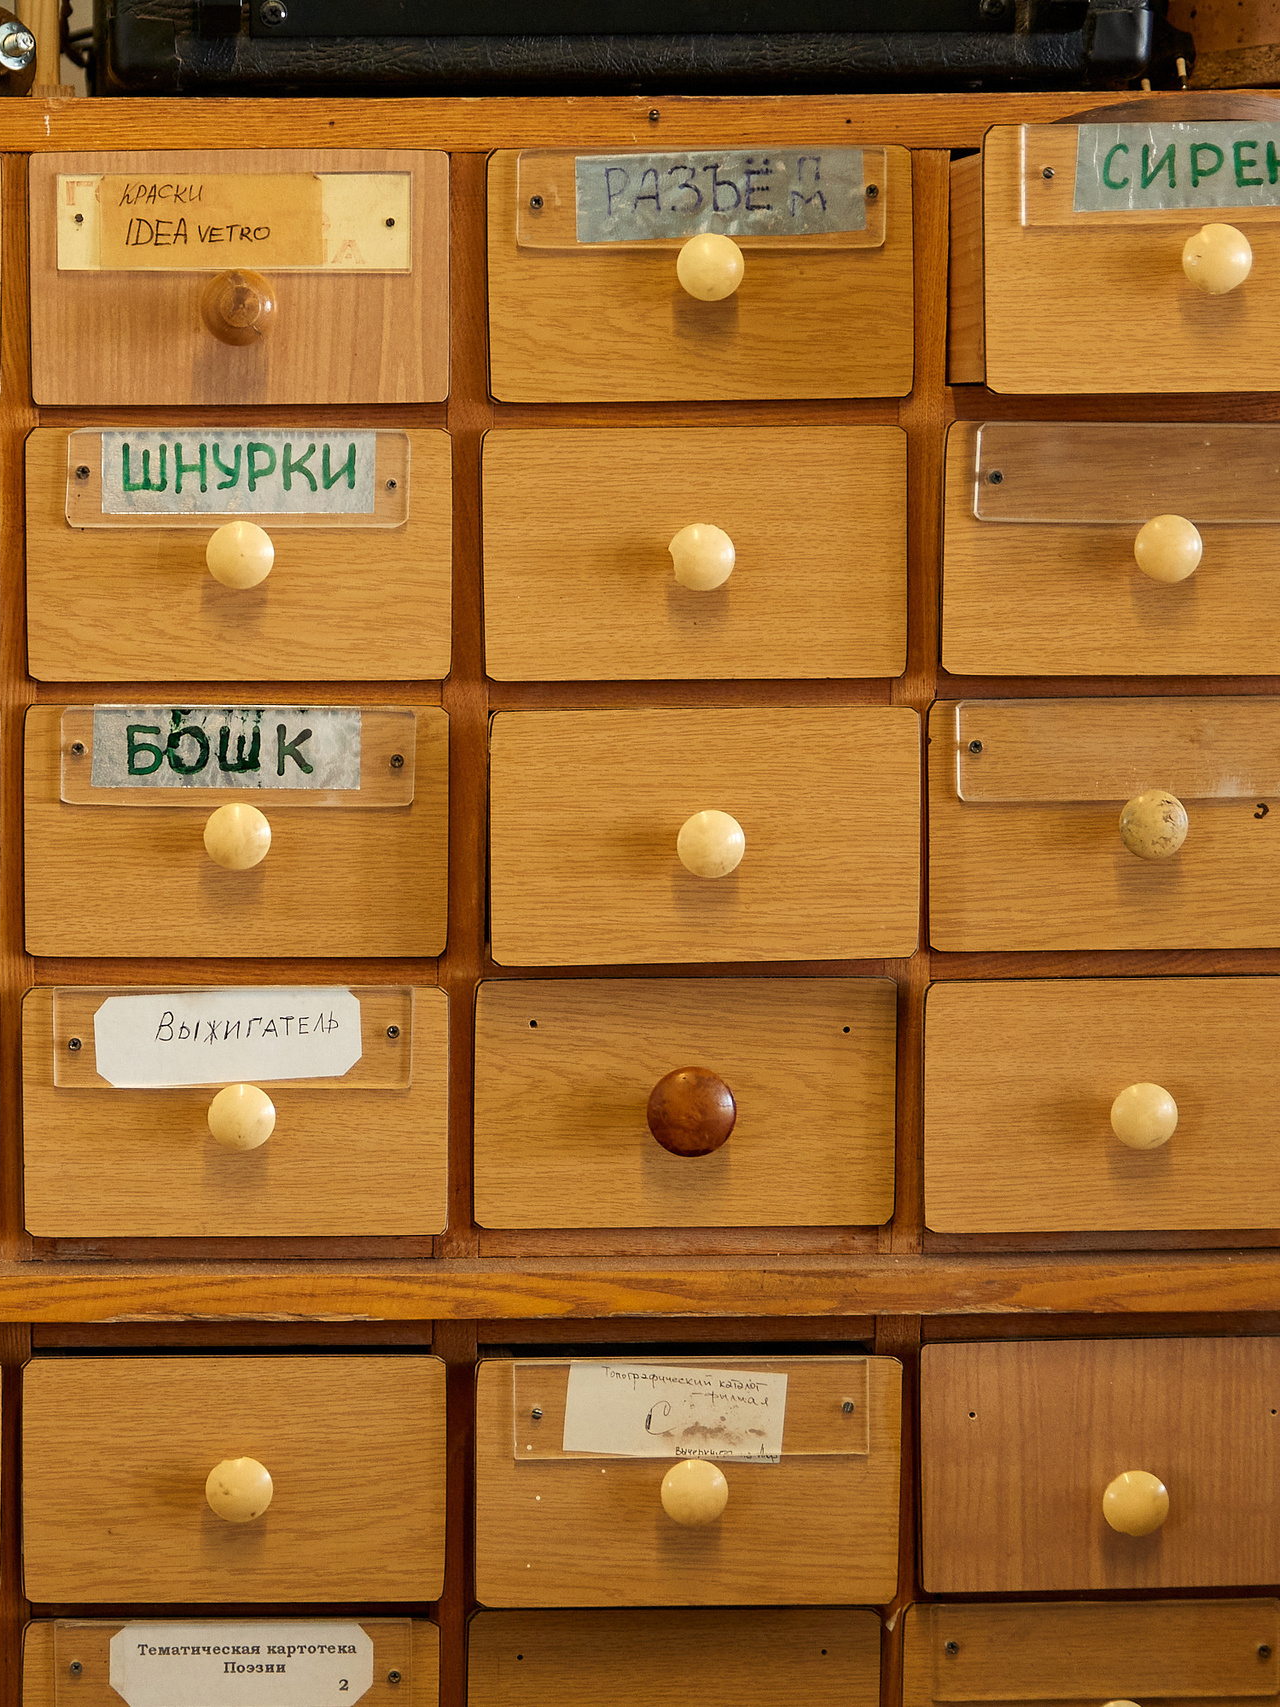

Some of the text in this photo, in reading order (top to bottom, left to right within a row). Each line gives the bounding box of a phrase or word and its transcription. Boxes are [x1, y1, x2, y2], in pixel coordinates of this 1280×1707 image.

[119, 183, 203, 207] КРАСКИ
[125, 218, 271, 246] IDEA VETRO
[122, 442, 356, 494] ШНУРКИ
[137, 1643, 357, 1658] Тематическая картотека
[223, 1661, 287, 1673] Поэзии
[338, 1679, 350, 1691] 2
